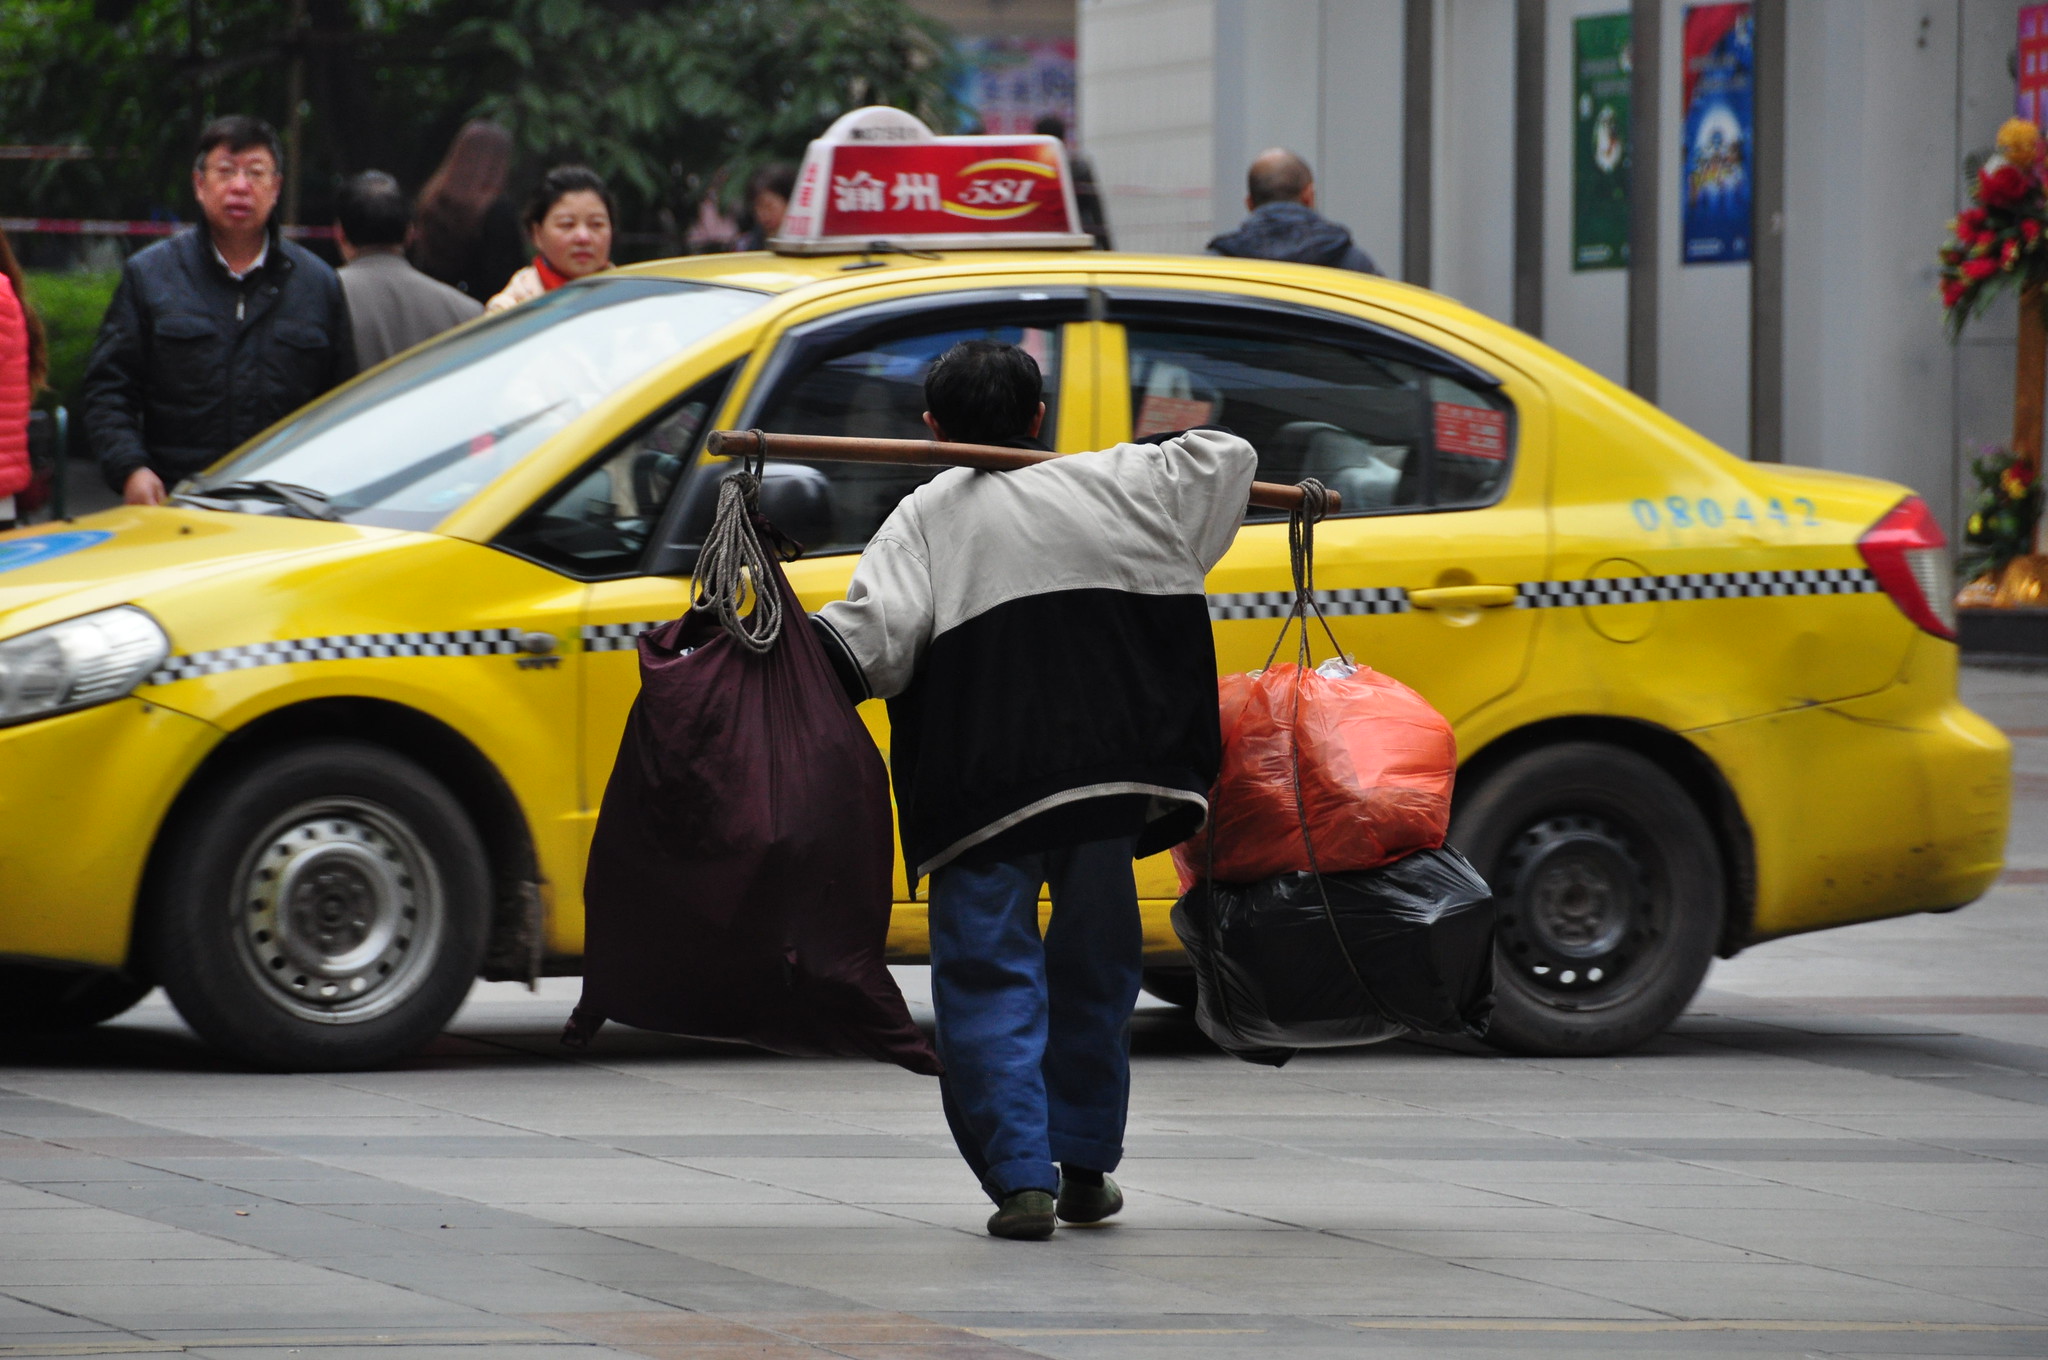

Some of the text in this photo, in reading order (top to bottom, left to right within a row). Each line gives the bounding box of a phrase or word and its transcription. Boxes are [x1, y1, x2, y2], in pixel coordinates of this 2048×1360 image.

[833, 170, 942, 212] 渝州
[958, 178, 1036, 204] 581
[1631, 495, 1821, 531] 080442
